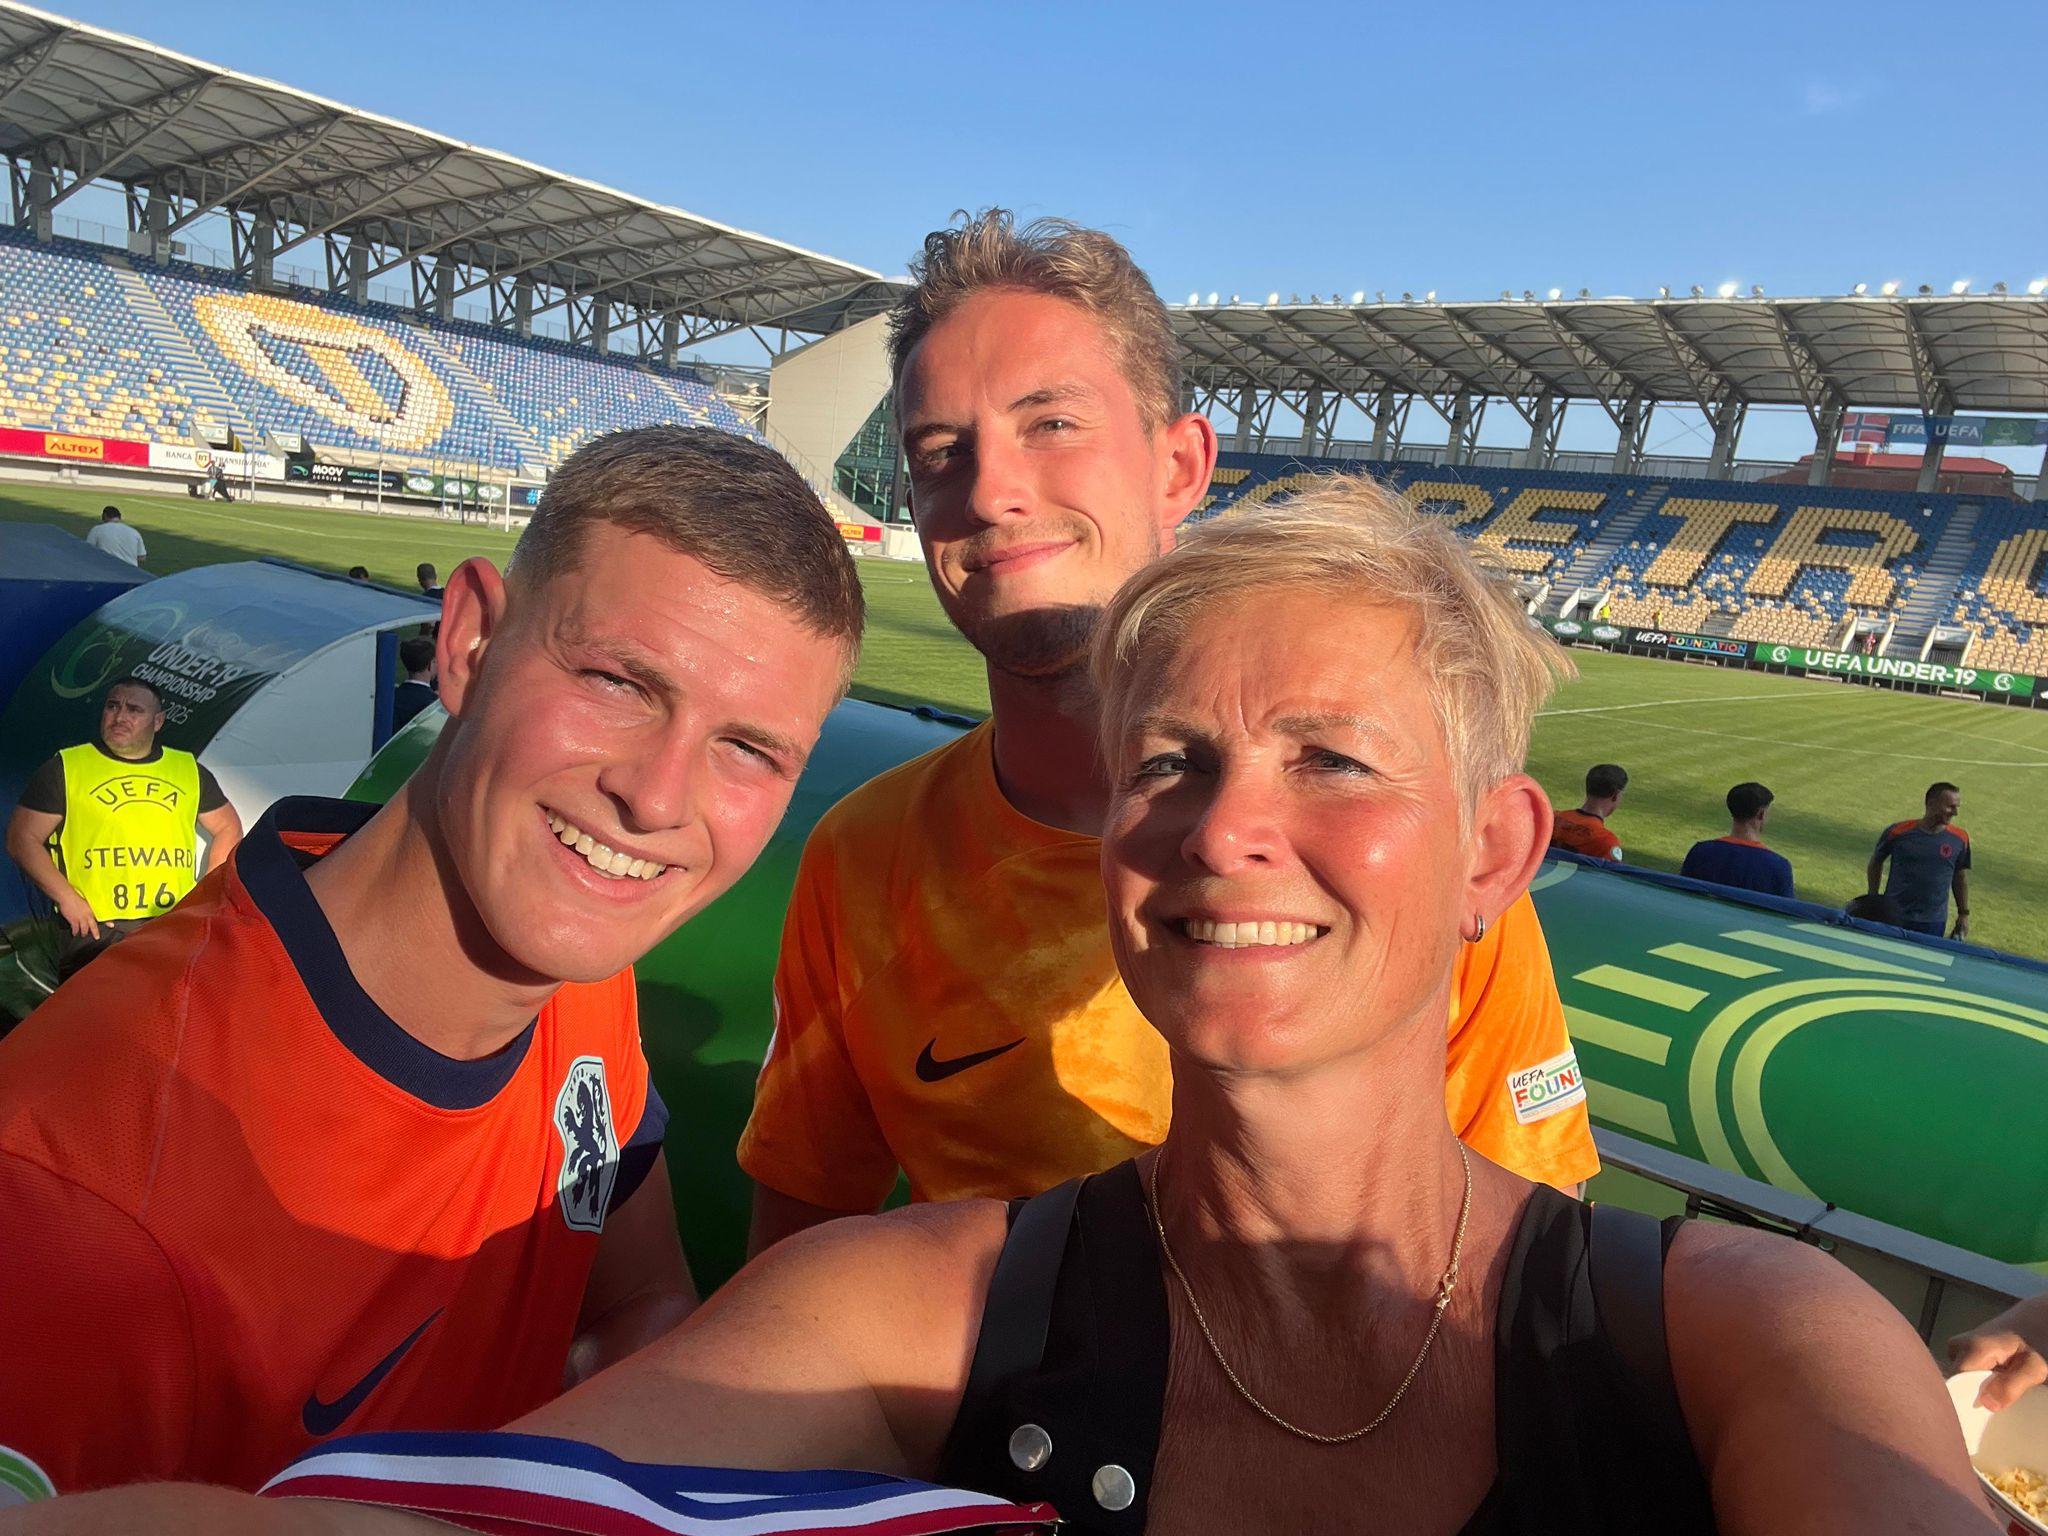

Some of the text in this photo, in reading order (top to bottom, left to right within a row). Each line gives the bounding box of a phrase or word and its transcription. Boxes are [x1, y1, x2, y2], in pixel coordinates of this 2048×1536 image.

[1892, 423, 1926, 435] FIFA
[1935, 424, 1980, 439] UEFA
[165, 451, 192, 460] BANCA
[312, 465, 344, 476] MOOV
[1636, 631, 1669, 645] UEFA
[1668, 635, 1748, 654] FOUNDATION
[148, 641, 243, 687] UNDER-19
[1804, 649, 1978, 686] UEFA UNDER-19
[131, 662, 216, 703] CHAMPIONSHIP
[96, 781, 178, 807] UEFA
[84, 847, 193, 869] STEWARD
[113, 882, 176, 910] 816
[1512, 1068, 1545, 1089] UEFA
